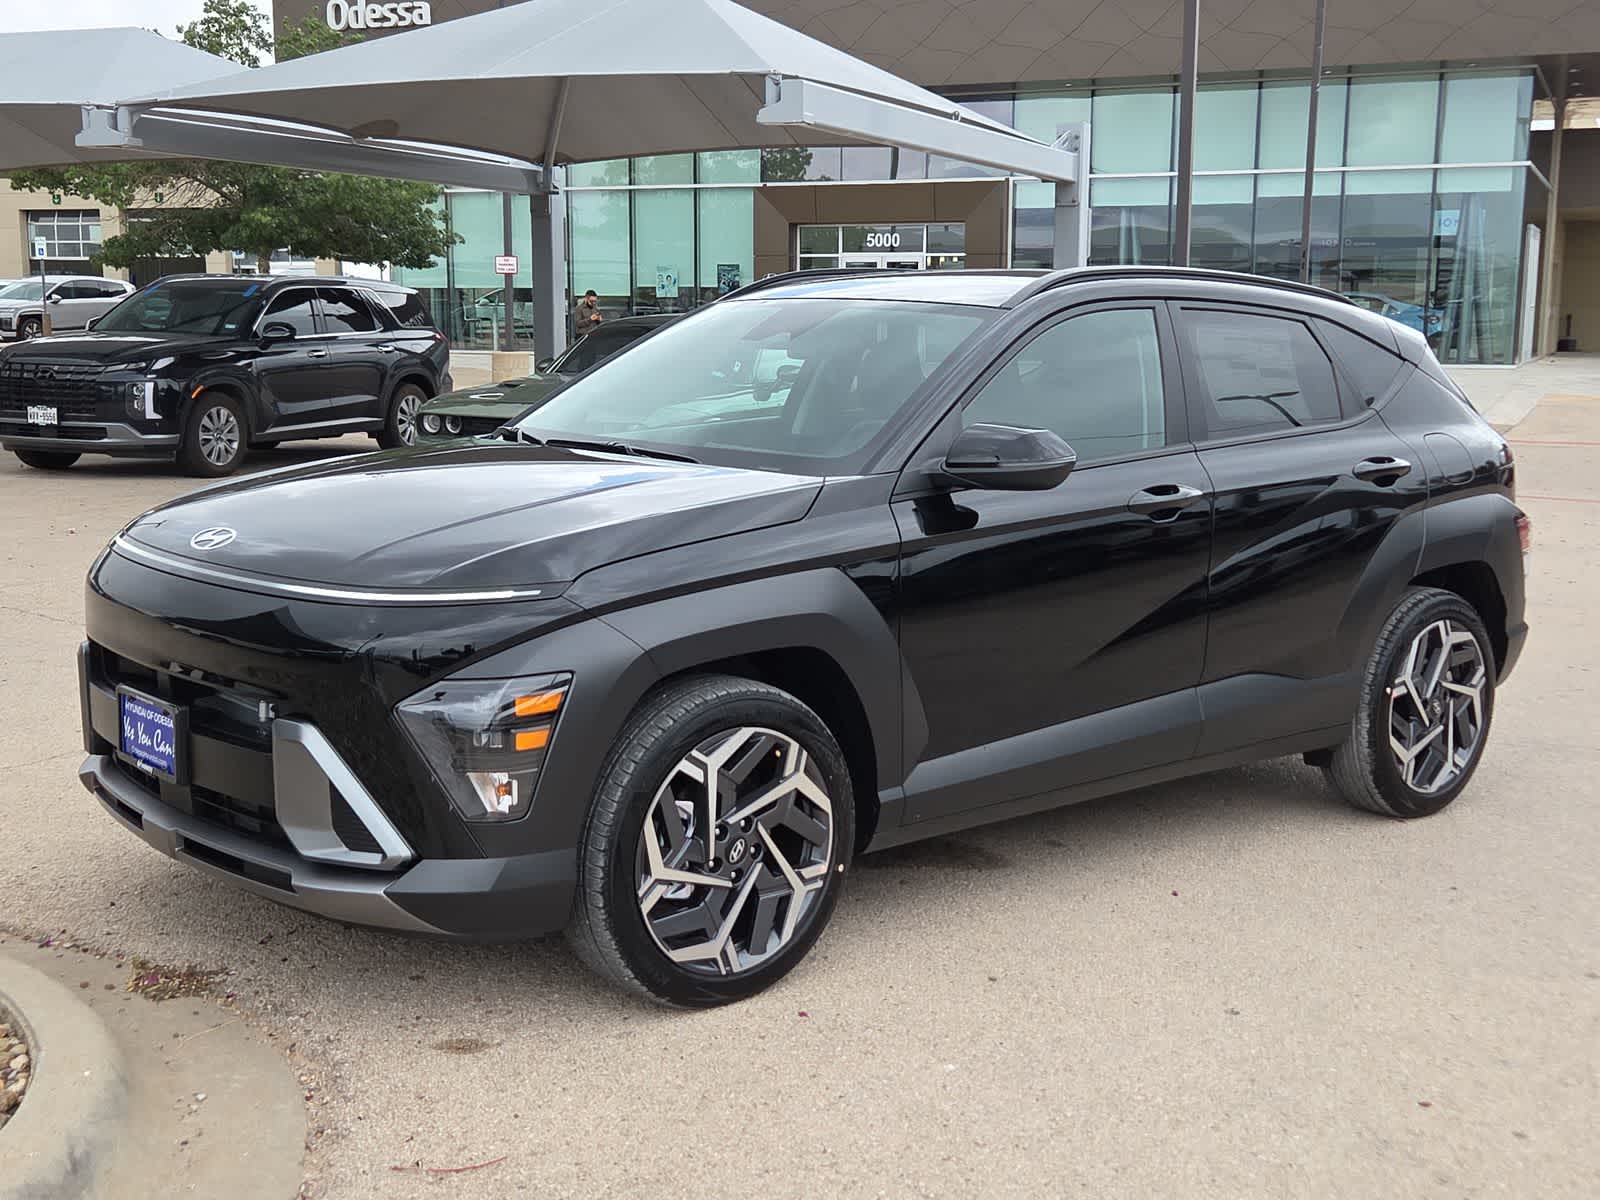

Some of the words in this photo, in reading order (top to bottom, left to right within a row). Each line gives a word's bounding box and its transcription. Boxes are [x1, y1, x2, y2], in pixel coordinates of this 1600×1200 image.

[326, 0, 432, 31] Odessa
[866, 232, 901, 248] 5000
[125, 700, 147, 718] HYUNDAI
[154, 712, 174, 728] ODESSA
[123, 715, 135, 740] Yes
[137, 722, 151, 746] You
